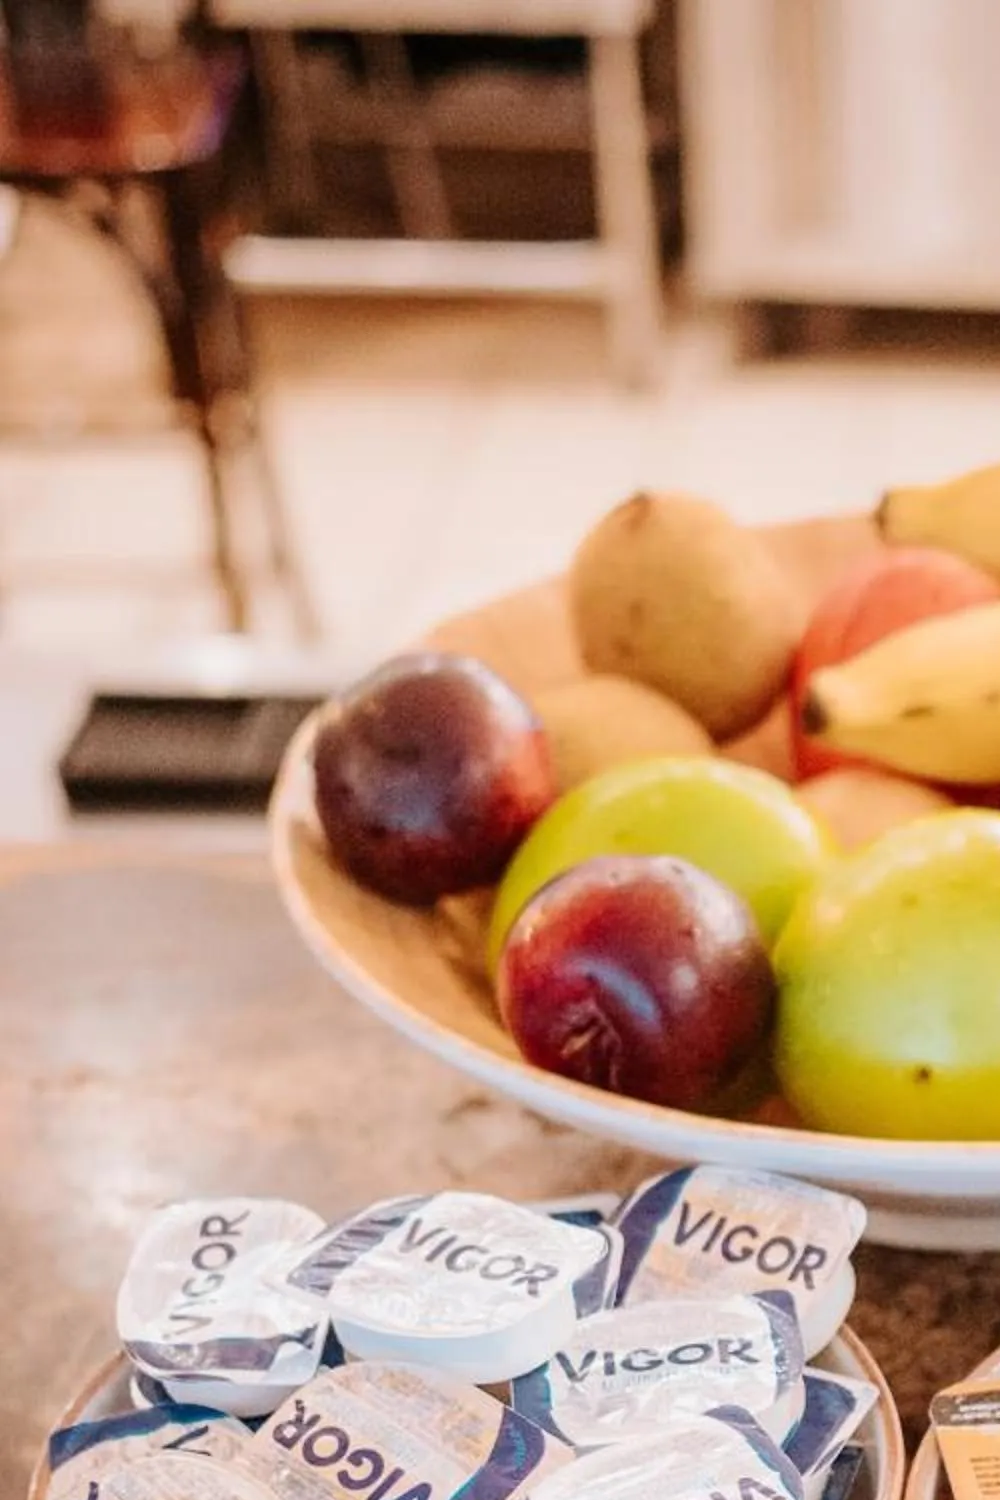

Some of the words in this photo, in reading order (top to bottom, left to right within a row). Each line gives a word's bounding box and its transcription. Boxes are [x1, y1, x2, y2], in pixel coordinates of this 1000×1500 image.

[163, 1210, 250, 1340] VIGOR
[399, 1217, 559, 1297] VIGOR
[674, 1201, 827, 1290] VIGOR
[554, 1338, 760, 1383] VIGOR
